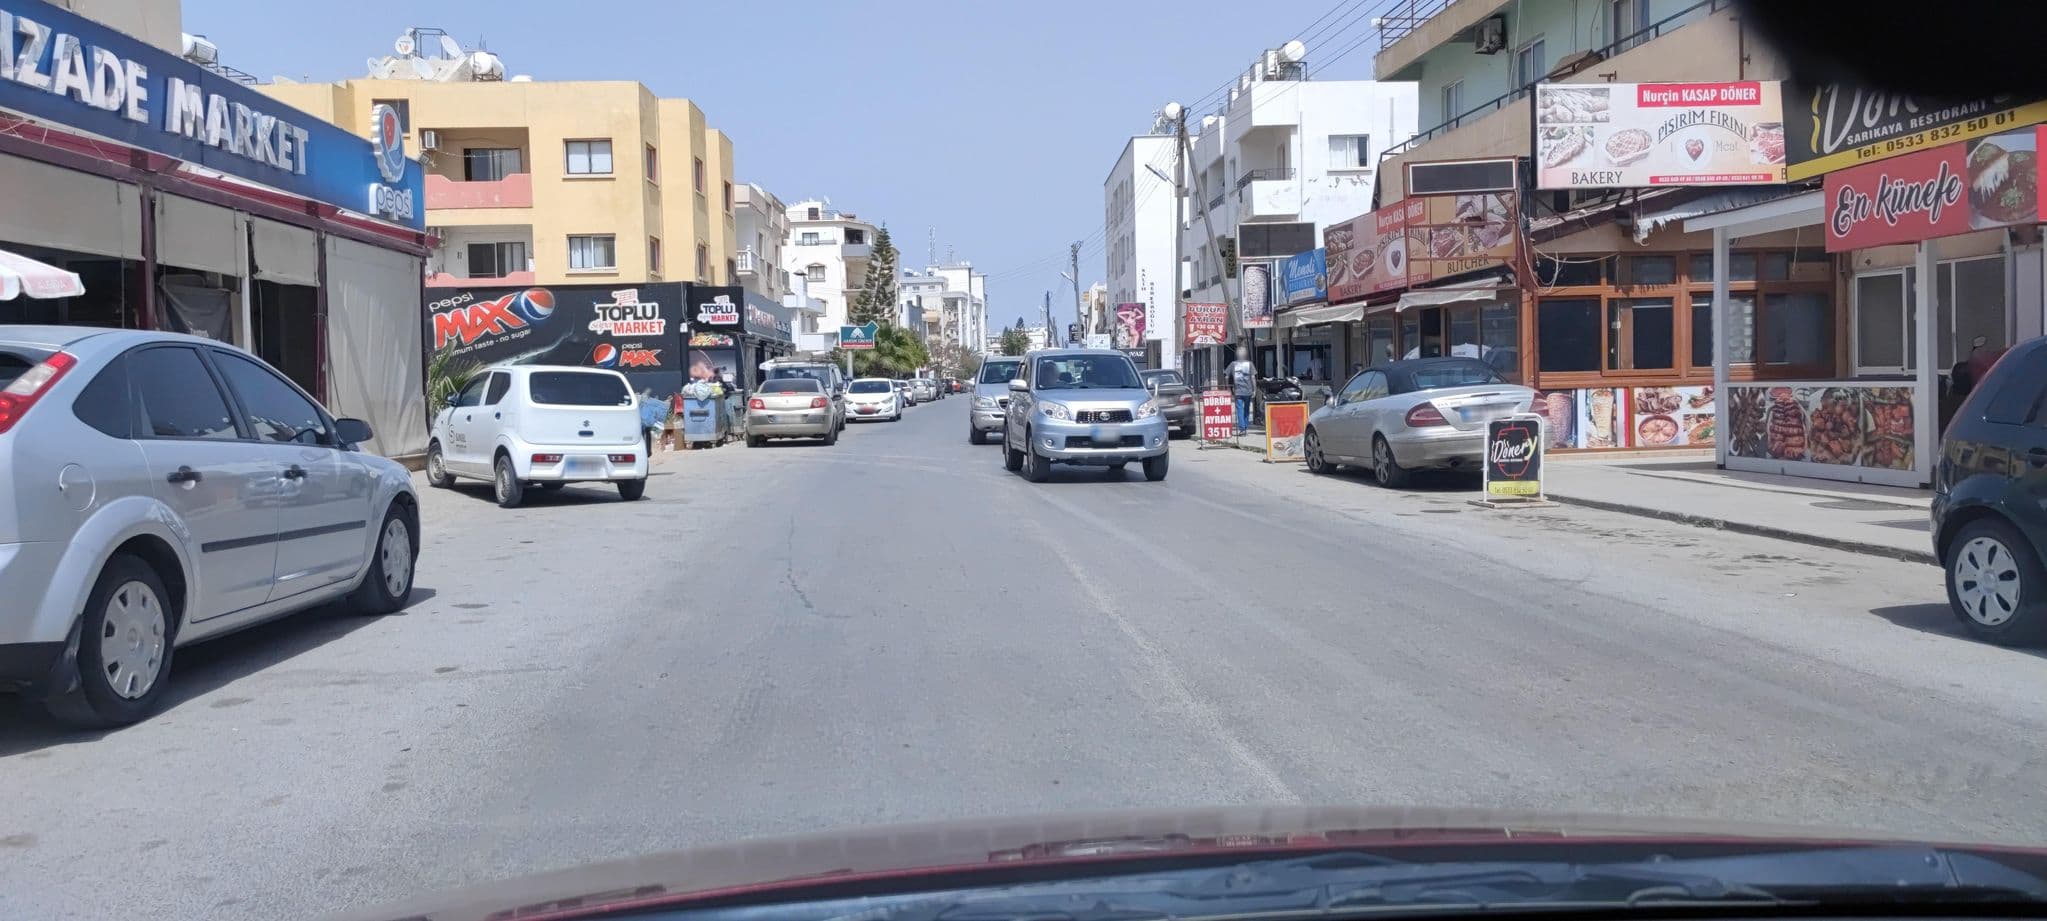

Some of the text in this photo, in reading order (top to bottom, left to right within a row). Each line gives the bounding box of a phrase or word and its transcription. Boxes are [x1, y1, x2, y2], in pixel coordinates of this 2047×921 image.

[1643, 86, 1757, 105] Nurçin KASAP DÖNER
[165, 77, 309, 175] MARKET
[1710, 110, 1747, 139] FIRINI
[1847, 122, 1903, 146] SARIKAYA
[1856, 110, 2016, 160] Tel: 0533 832 50 01
[1572, 171, 1623, 185] BAKERY
[369, 183, 414, 220] pepsi
[1831, 160, 1963, 238] En künefe
[1393, 207, 1405, 223] KASA
[1447, 253, 1490, 274] BUTCHER
[428, 292, 475, 313] pepsi
[703, 305, 733, 314] TOPLU
[432, 292, 530, 351] MAX
[597, 305, 657, 321] TOPLU
[711, 314, 737, 322] MARKET
[613, 321, 664, 334] MARKET
[474, 340, 495, 350] taste
[499, 335, 510, 343] no
[619, 349, 662, 367] MAX
[1204, 396, 1232, 406] DÜRÜM
[1204, 415, 1232, 425] AYRAN
[1207, 427, 1231, 438] 35 TL
